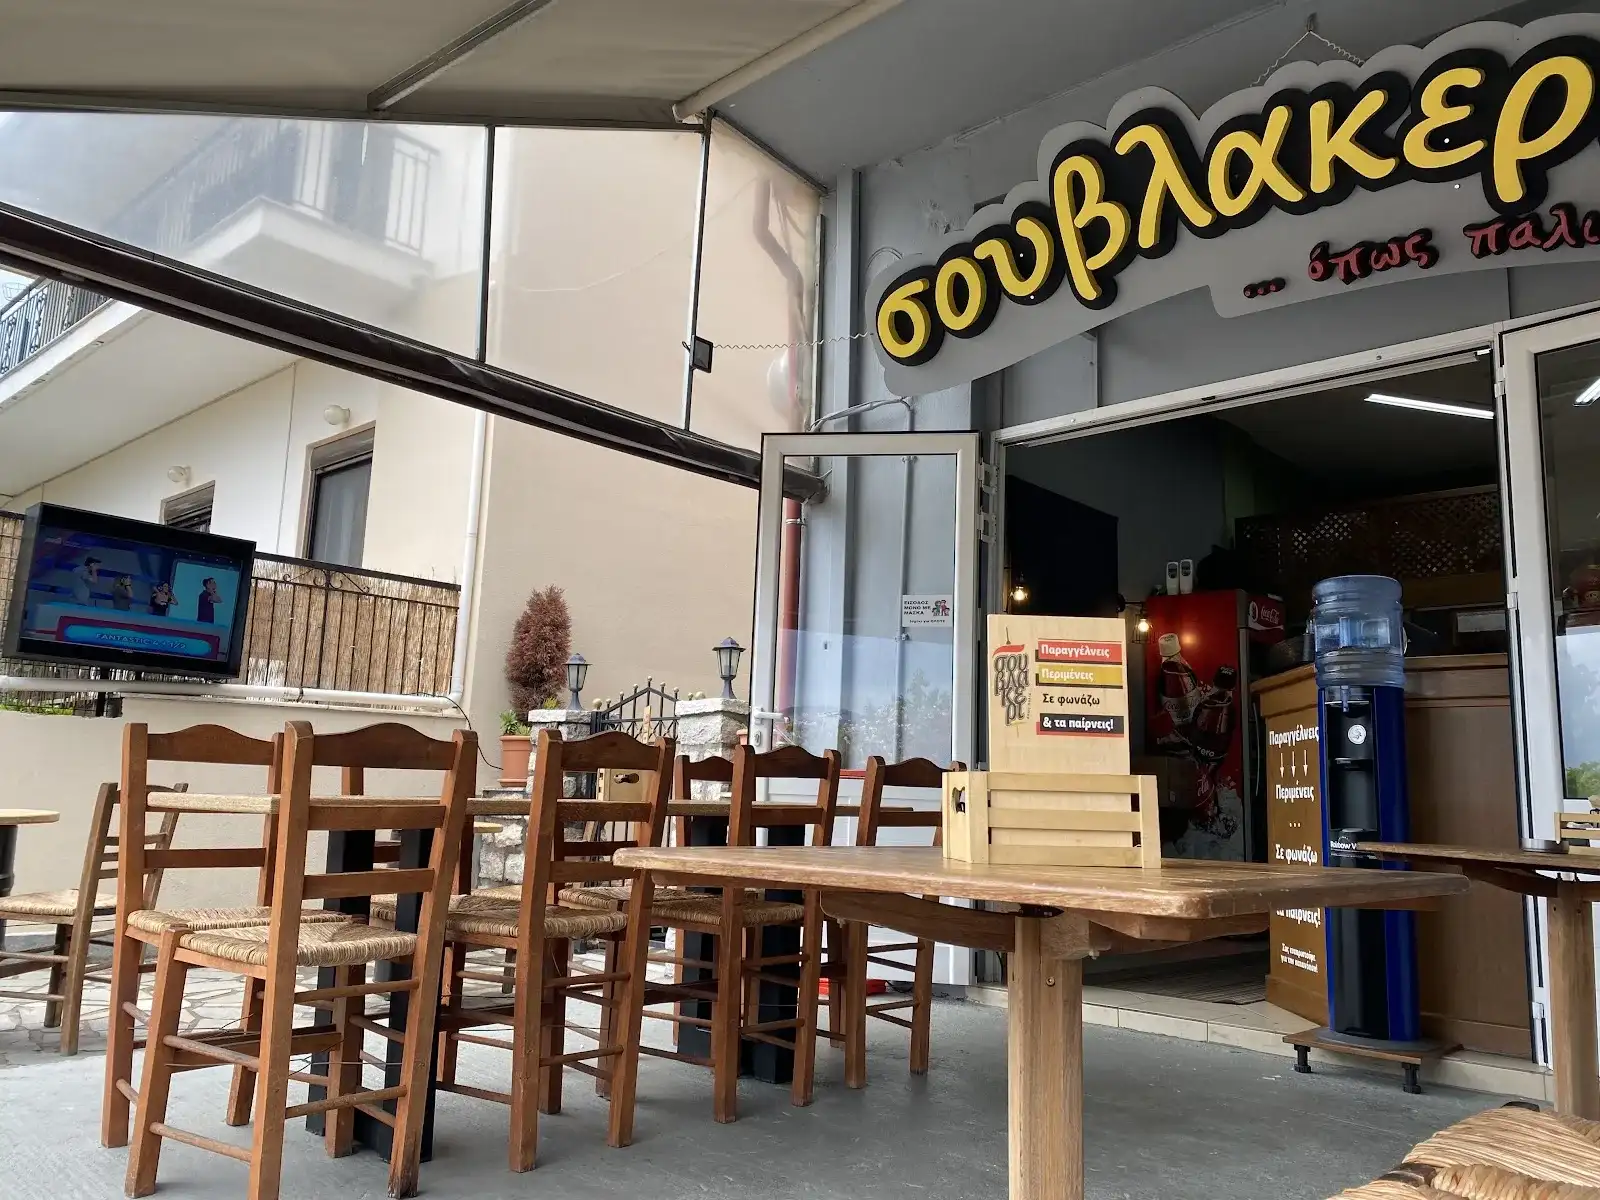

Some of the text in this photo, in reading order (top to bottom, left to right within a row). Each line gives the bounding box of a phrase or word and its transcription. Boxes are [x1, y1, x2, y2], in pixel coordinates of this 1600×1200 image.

[1308, 231, 1433, 279] όπως
[95, 632, 150, 645] FANTASTIC
[1041, 643, 1110, 657] Παραγγέλνεις
[1041, 668, 1094, 682] Περιμένεις
[1042, 693, 1101, 707] Σε φωνάζω
[1042, 716, 1114, 730] & τα παίρνεις!
[1269, 724, 1319, 748] Παραγγέλνεις
[1275, 780, 1314, 802] Περιμένεις
[1275, 843, 1318, 866] Σε φωνάζω
